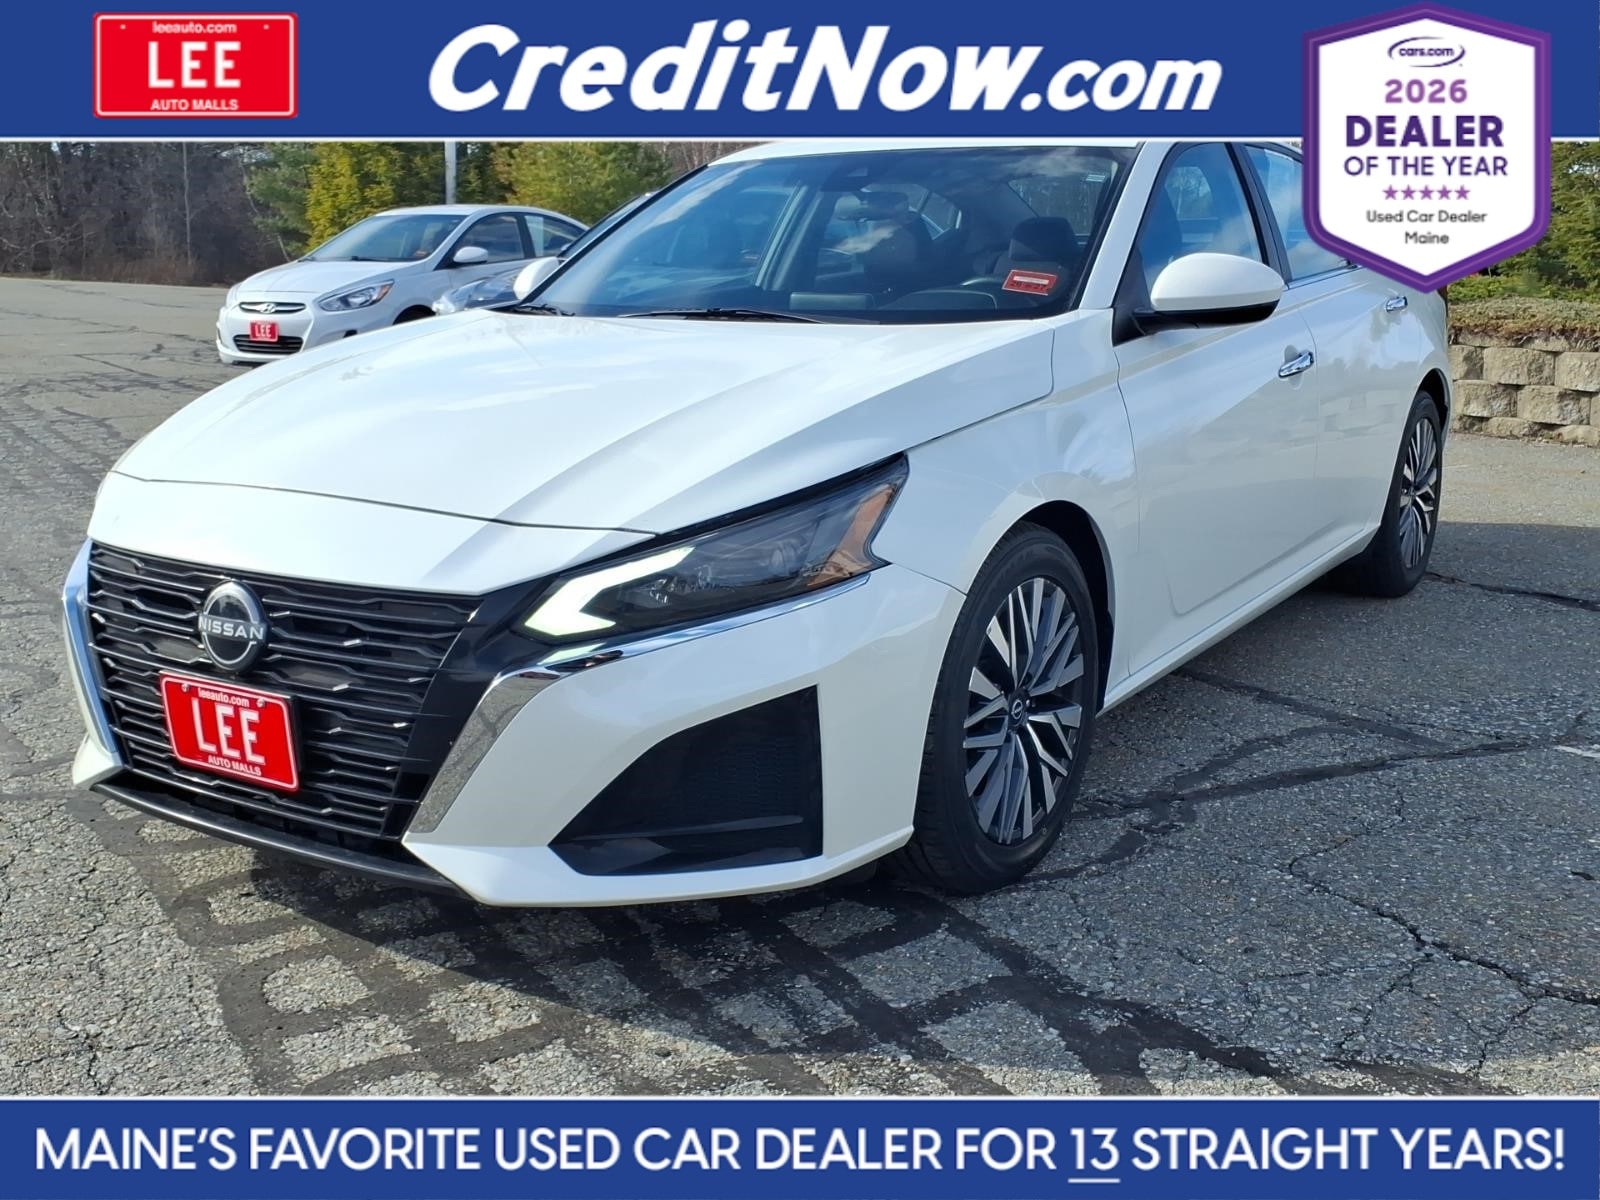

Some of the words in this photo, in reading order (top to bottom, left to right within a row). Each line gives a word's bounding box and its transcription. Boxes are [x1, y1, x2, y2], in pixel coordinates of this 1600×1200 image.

[255, 324, 272, 338] LEE
[198, 616, 265, 641] NISSAN
[198, 687, 250, 708] leeauto.com
[191, 698, 266, 764] LEE
[207, 755, 232, 769] AUTO
[232, 760, 262, 777] MALLS
